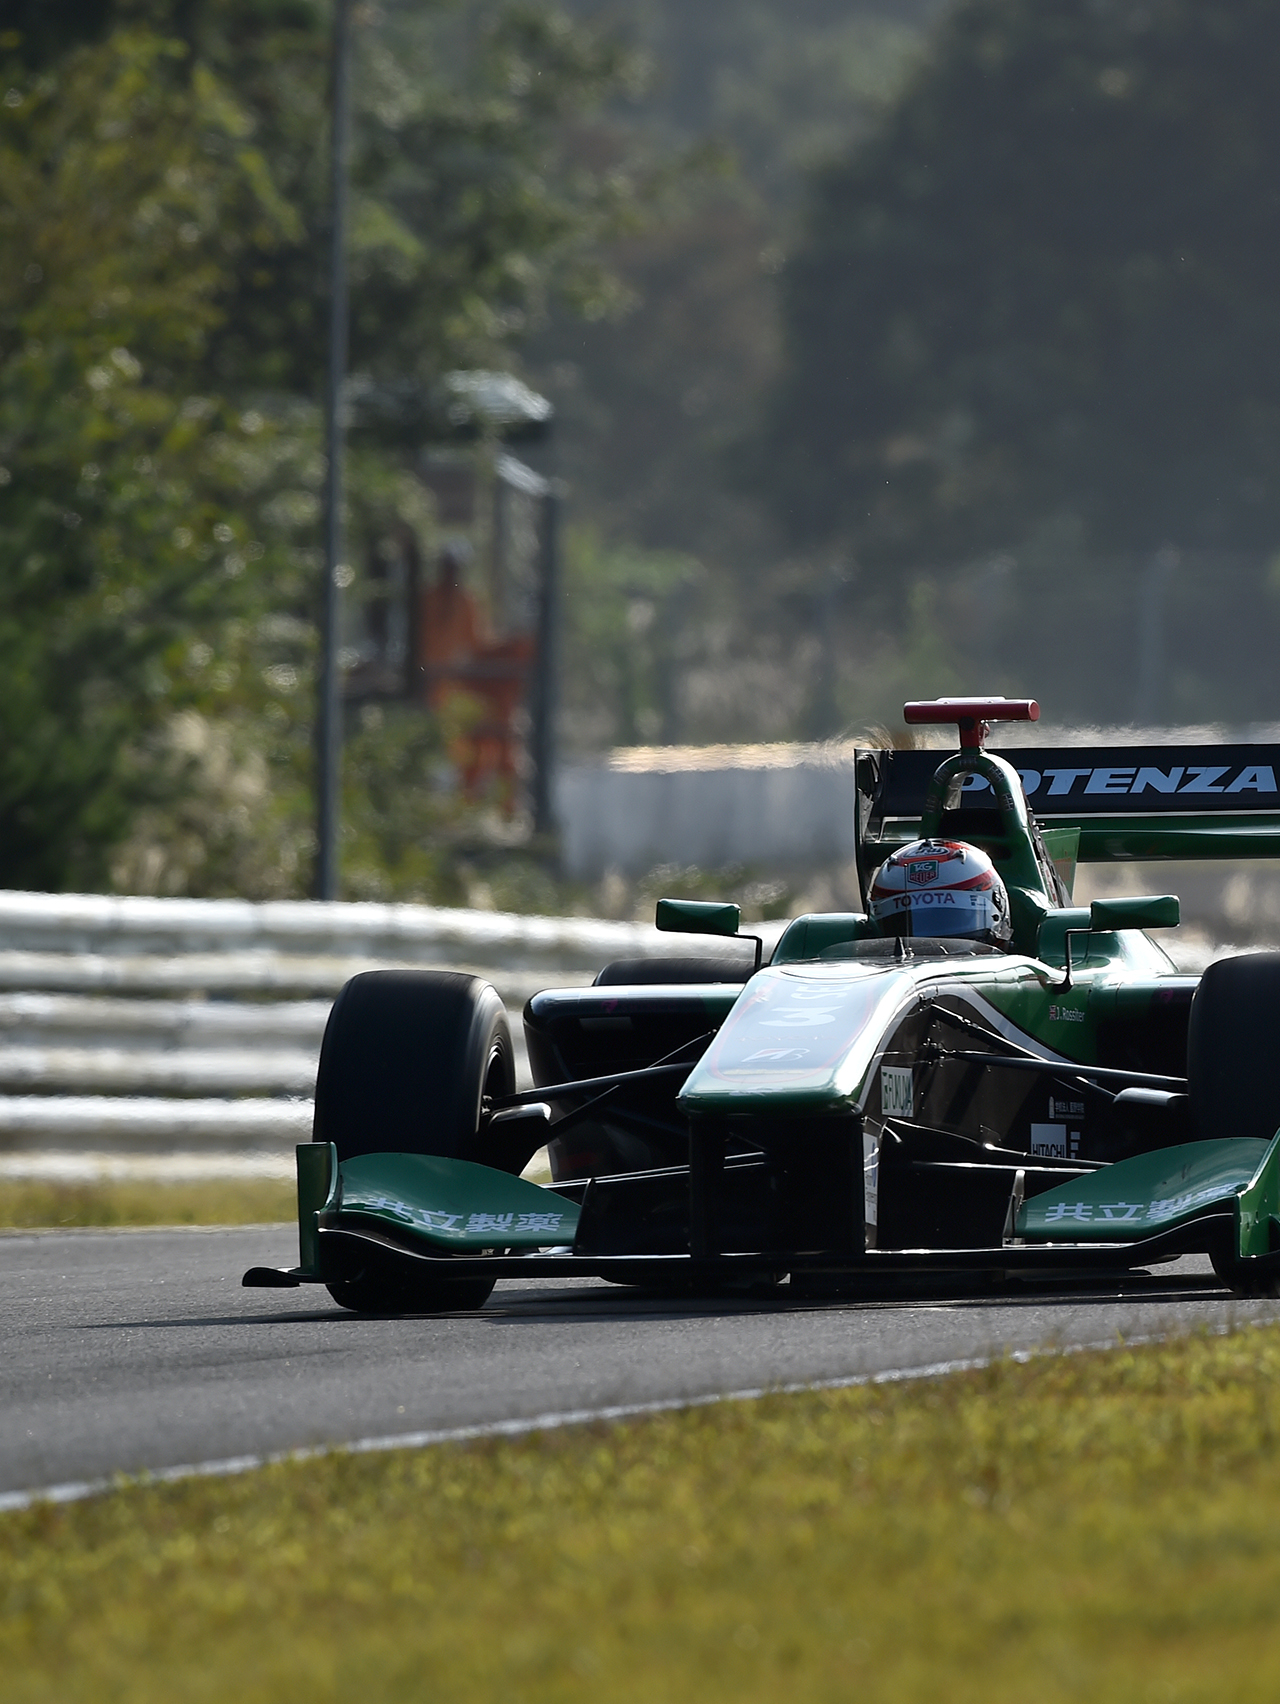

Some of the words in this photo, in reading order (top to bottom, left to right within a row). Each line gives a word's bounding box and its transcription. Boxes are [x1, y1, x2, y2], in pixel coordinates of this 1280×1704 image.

[913, 864, 933, 872] TAG
[910, 871, 937, 883] HEUER
[893, 892, 956, 909] TOYOTA
[1032, 1143, 1066, 1158] HITACHI
[364, 1197, 563, 1232] 共立製薬
